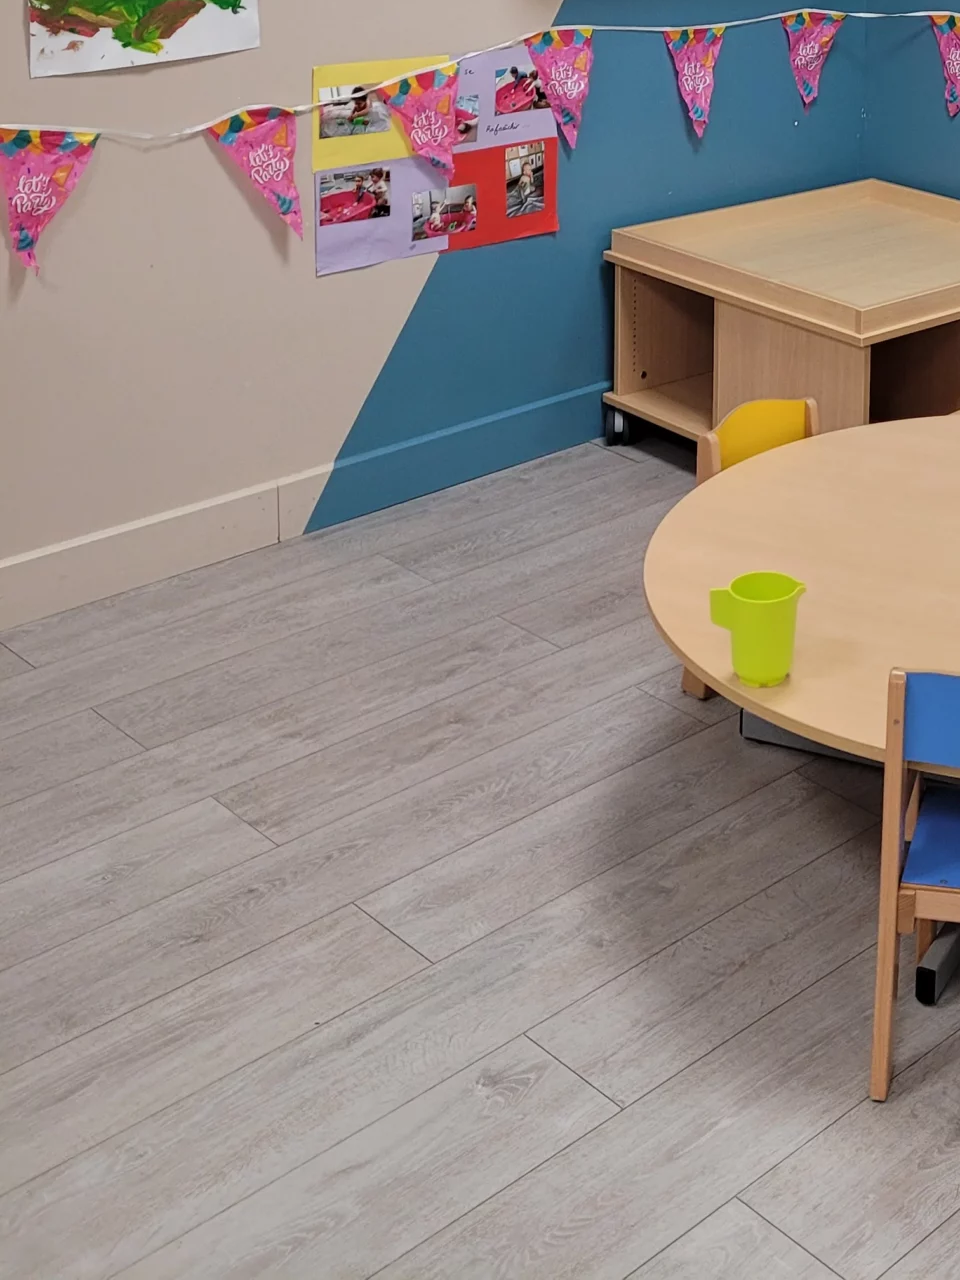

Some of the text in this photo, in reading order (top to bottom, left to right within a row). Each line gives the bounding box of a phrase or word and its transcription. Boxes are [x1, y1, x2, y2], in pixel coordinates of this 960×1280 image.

[547, 73, 585, 99] Party
[410, 119, 448, 146] Party
[251, 152, 290, 184] Party
[12, 187, 56, 216] Party
